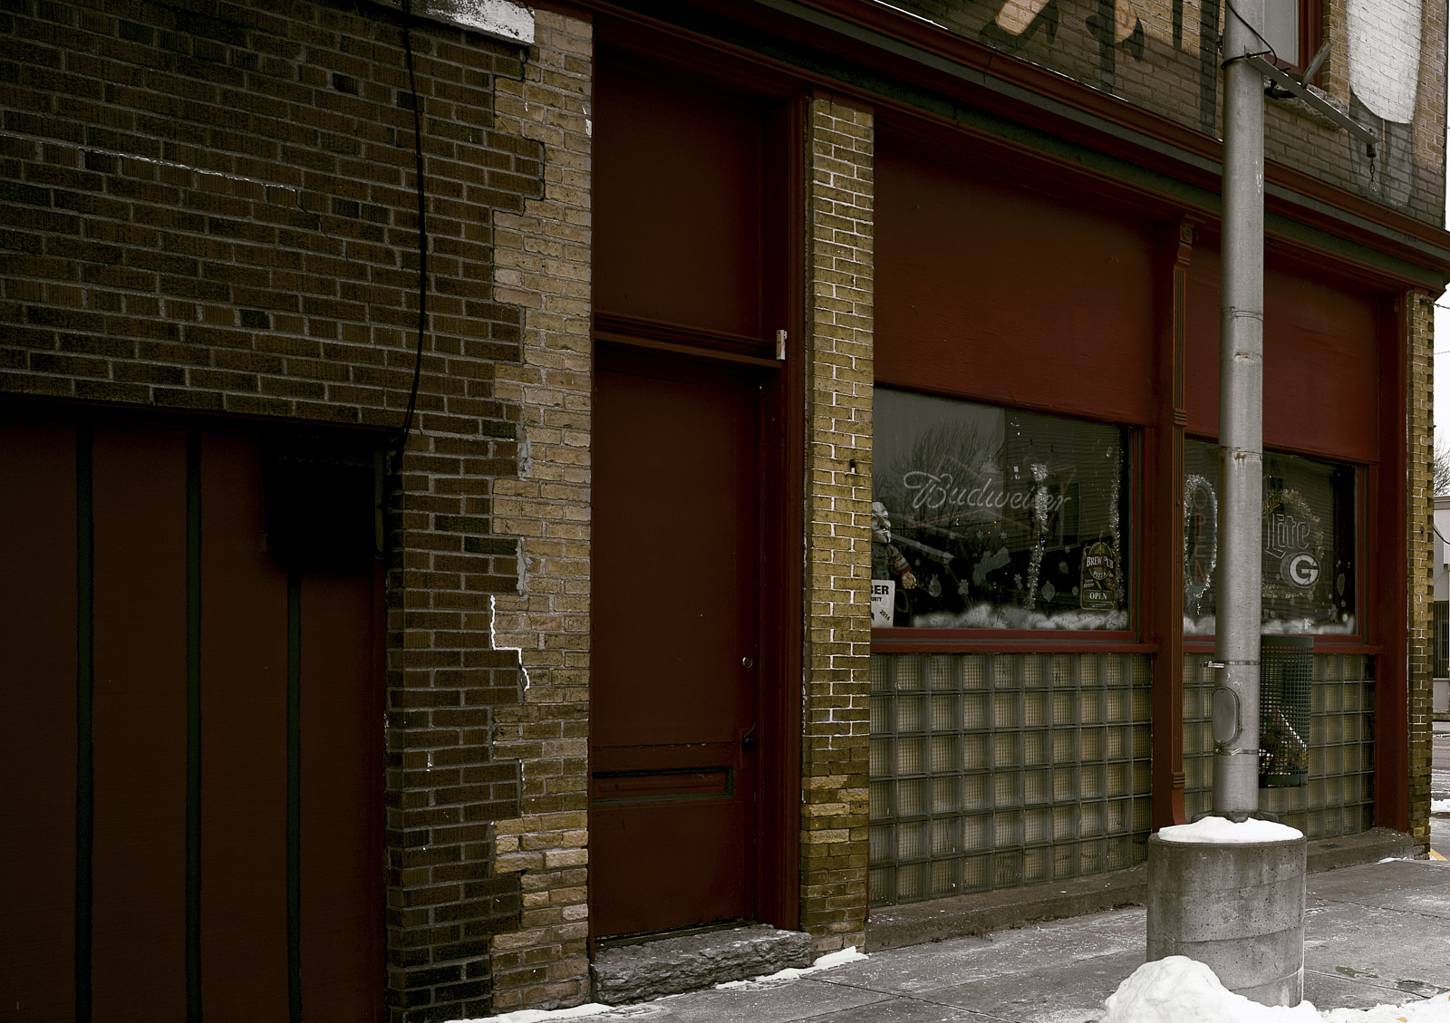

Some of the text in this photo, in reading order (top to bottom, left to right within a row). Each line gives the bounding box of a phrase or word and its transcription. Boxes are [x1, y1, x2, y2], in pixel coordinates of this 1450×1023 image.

[903, 470, 1073, 512] Budweier
[1264, 512, 1311, 560] Lite
[1289, 553, 1320, 586] G
[1088, 591, 1108, 600] OPEN
